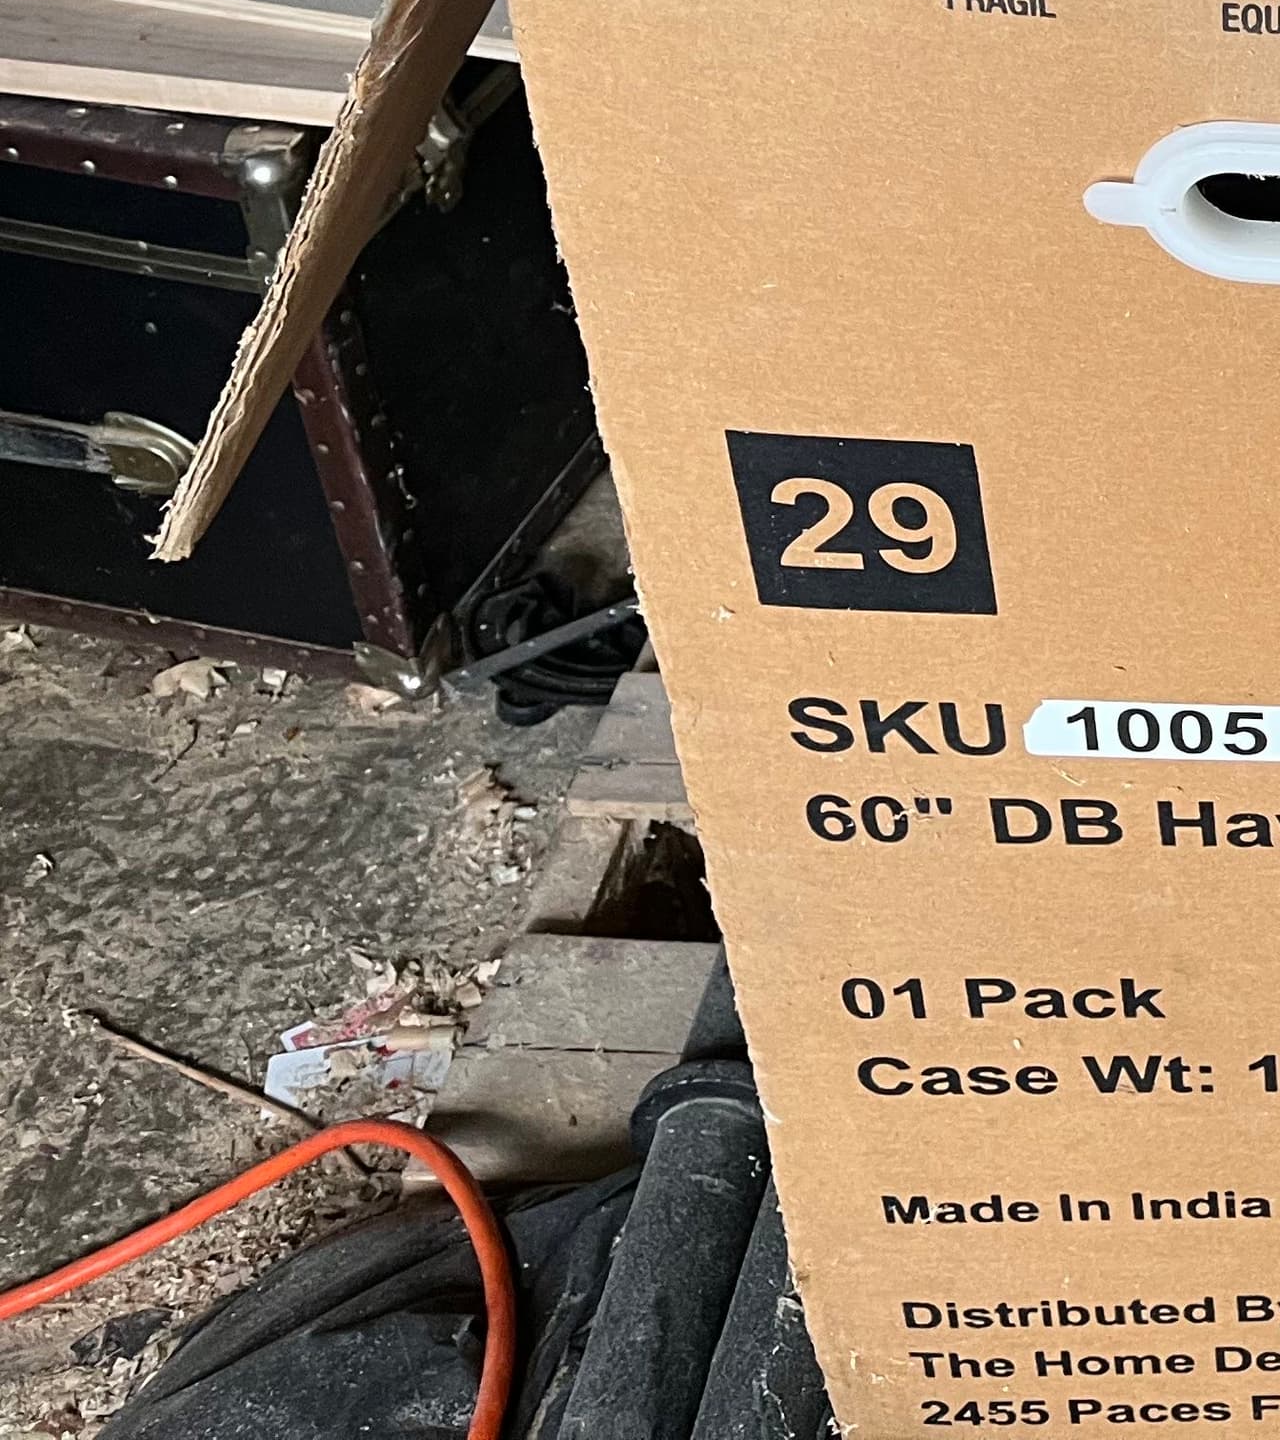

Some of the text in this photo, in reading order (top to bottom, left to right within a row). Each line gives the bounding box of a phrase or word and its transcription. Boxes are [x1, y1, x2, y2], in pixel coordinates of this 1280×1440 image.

[770, 477, 957, 574] 29
[788, 697, 1007, 756] SKU
[1067, 706, 1268, 756] 1005
[806, 794, 953, 843] 60"
[989, 797, 1123, 846] DB
[841, 977, 1166, 1020] 01 Pack
[857, 1056, 1059, 1096] Case
[1081, 1055, 1214, 1094] Wt:
[881, 1190, 1272, 1225] Made In India
[901, 1296, 1216, 1329] Distributed
[908, 1351, 1015, 1379] The
[1034, 1350, 1195, 1377] Home
[921, 1400, 1050, 1426] 2455
[1068, 1399, 1232, 1425] Paces
